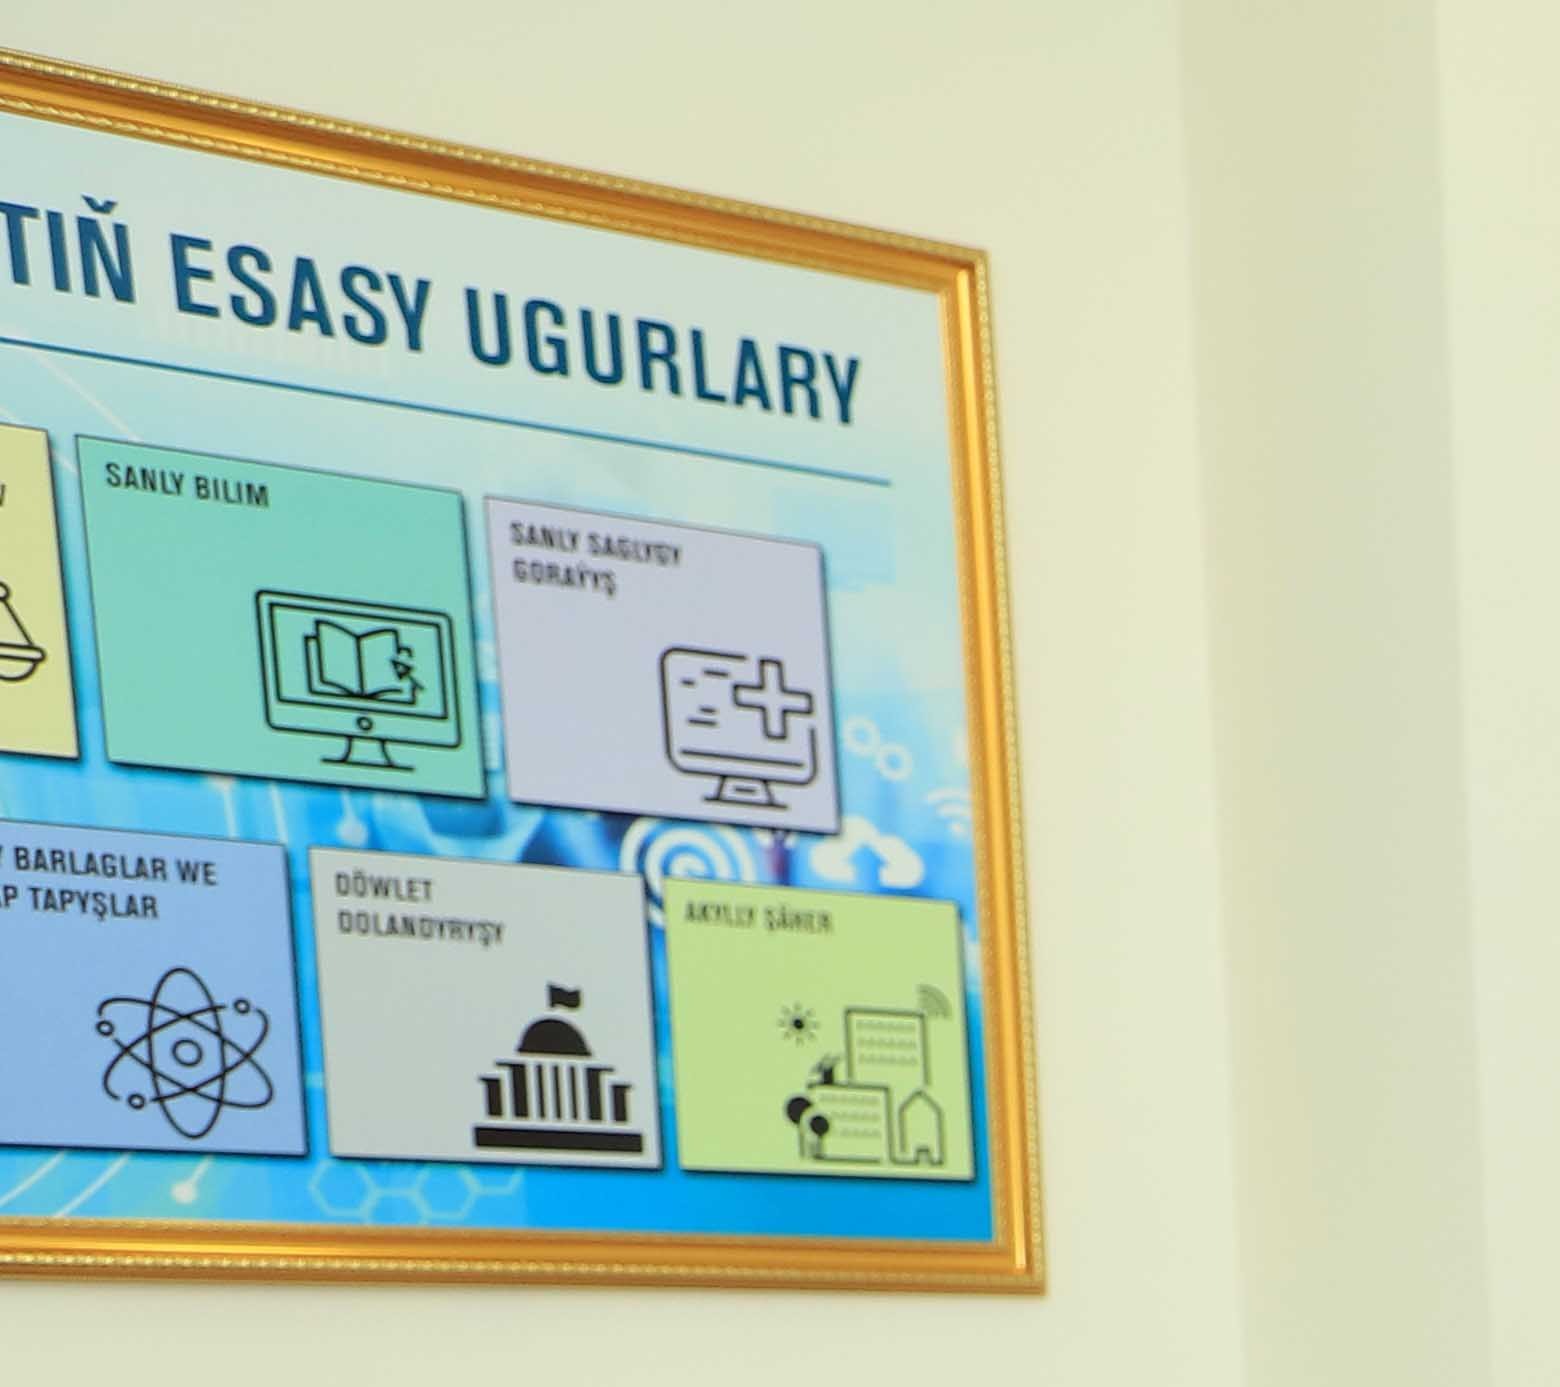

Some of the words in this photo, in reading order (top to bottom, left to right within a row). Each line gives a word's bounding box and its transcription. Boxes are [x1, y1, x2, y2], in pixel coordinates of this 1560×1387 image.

[171, 233, 433, 352] ESASY
[467, 289, 861, 425] UGURLARY
[105, 462, 187, 497] SANLY
[195, 474, 270, 510] BILIM
[511, 521, 579, 552] SANLY
[14, 845, 167, 880] BARLAGLAR
[177, 858, 217, 886] WE
[29, 886, 159, 921] TAPYŞLAR
[335, 867, 433, 903] DÖWLET
